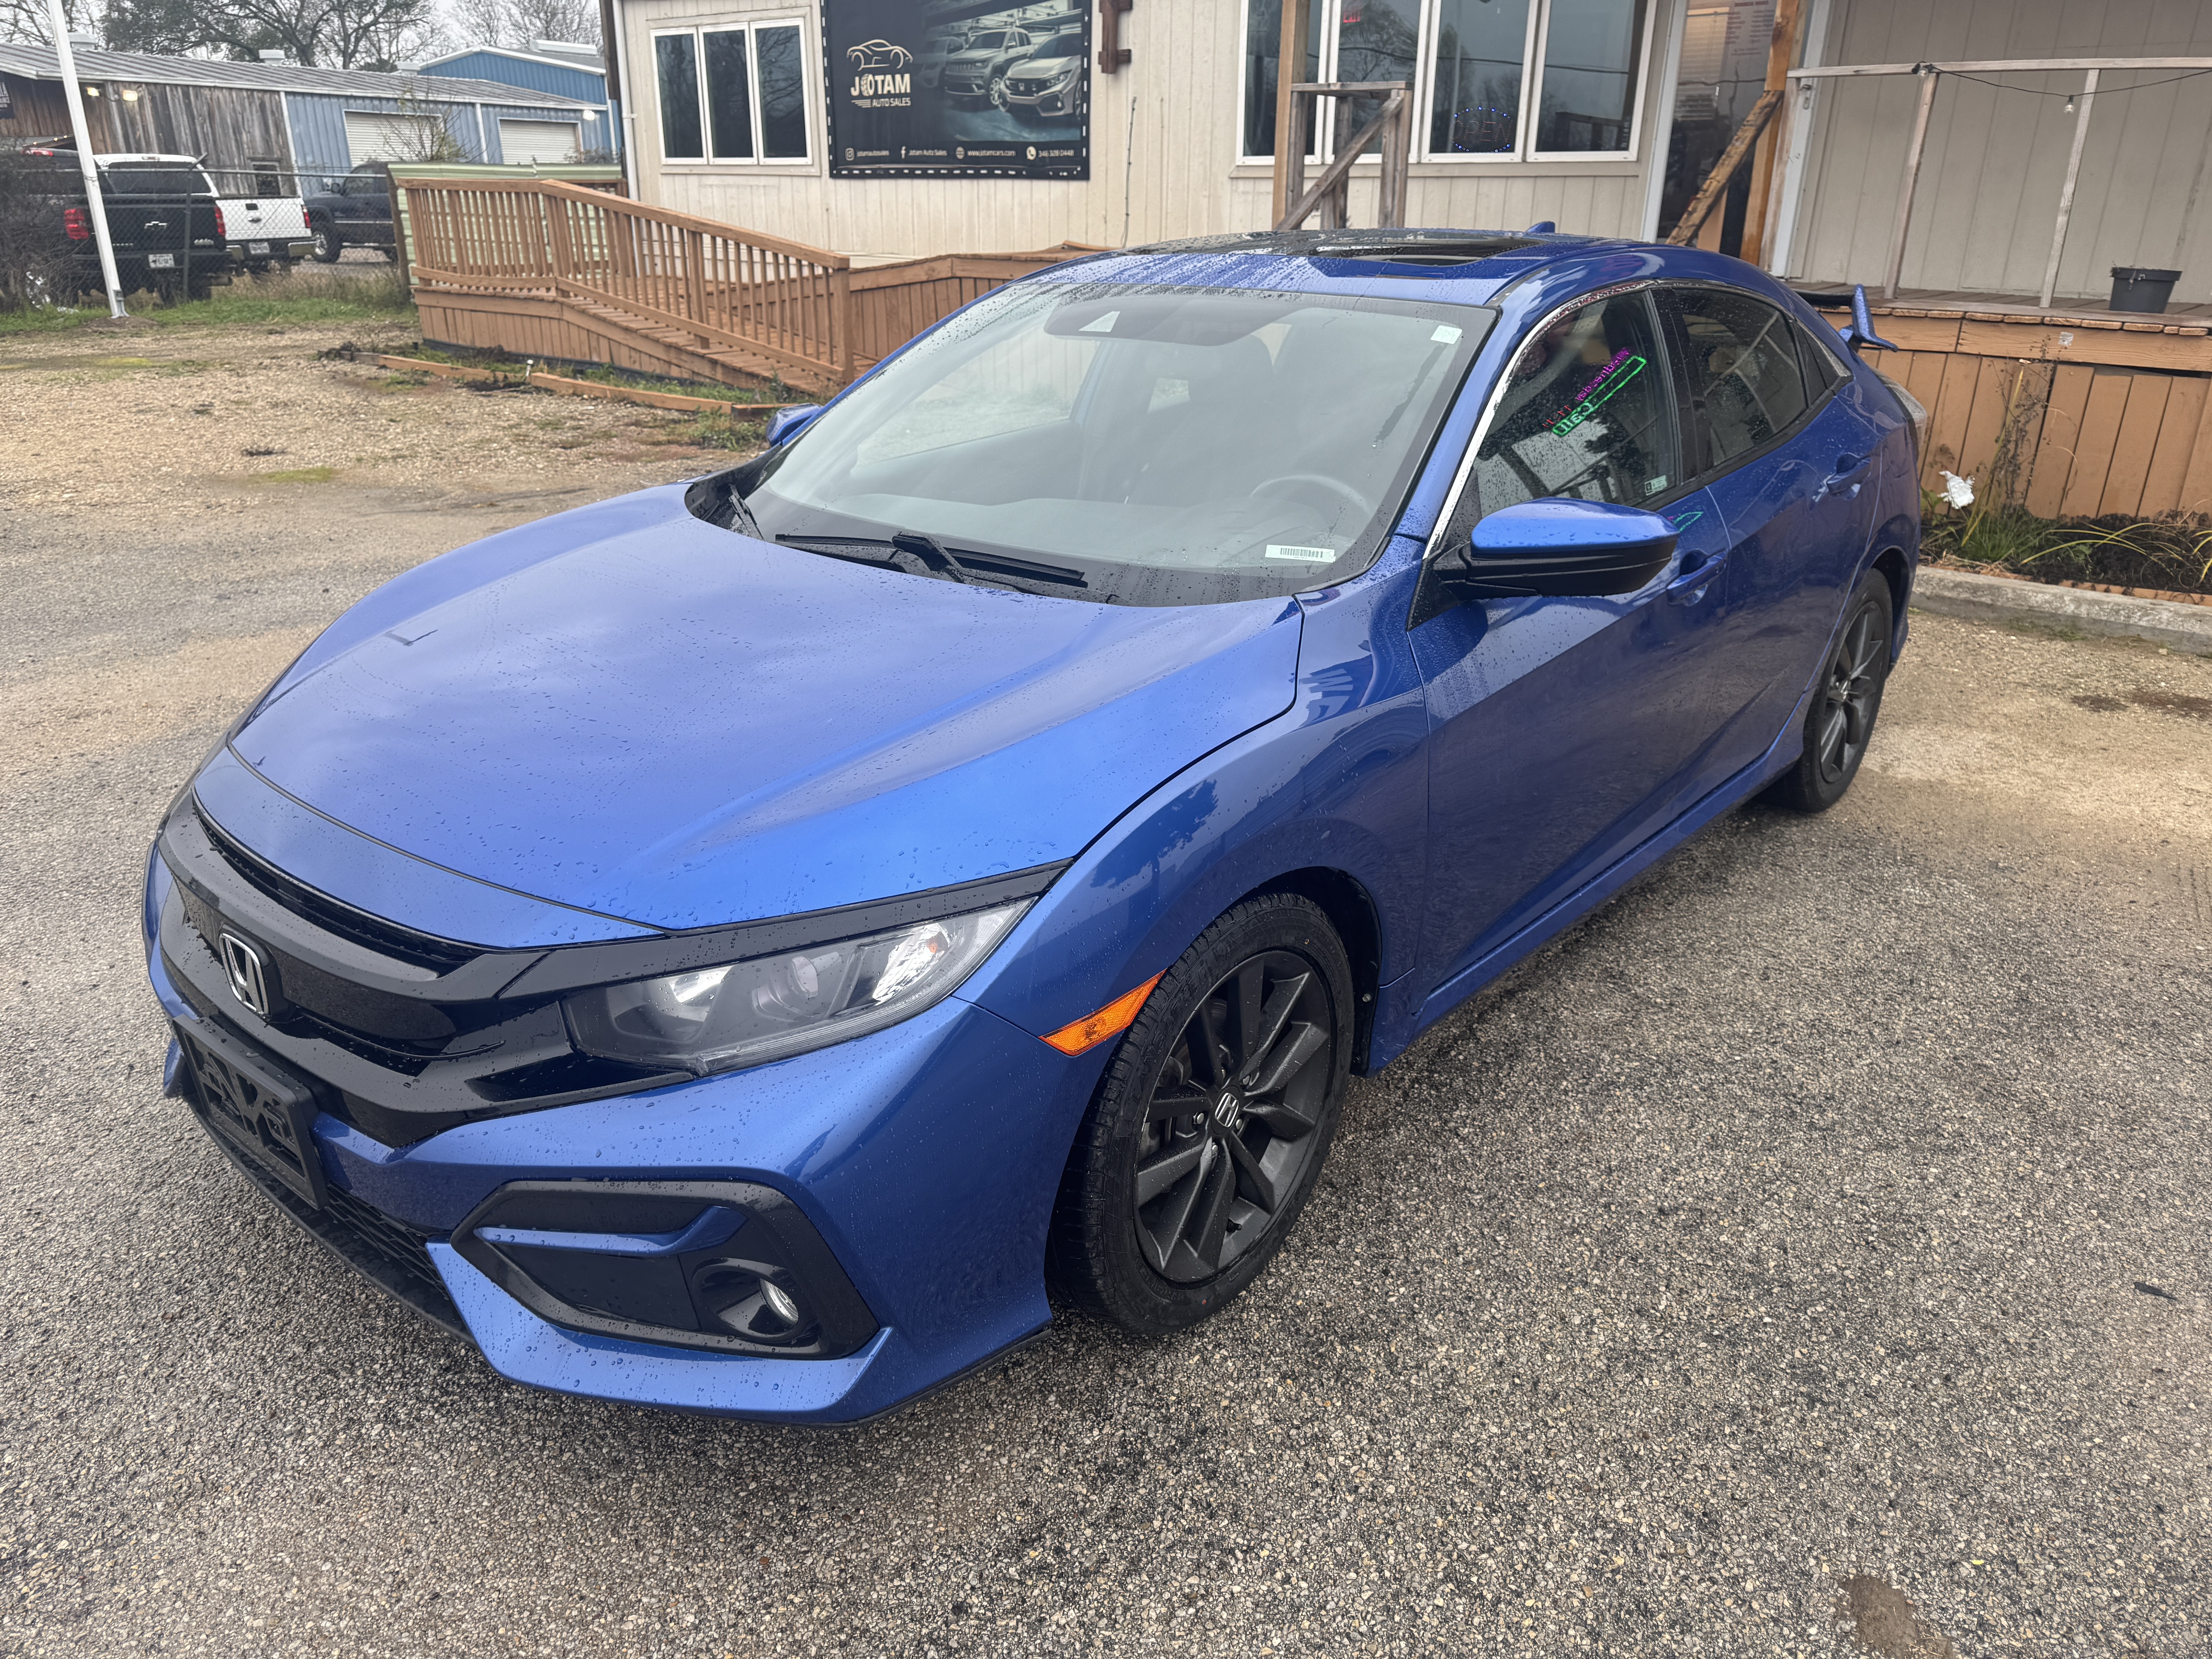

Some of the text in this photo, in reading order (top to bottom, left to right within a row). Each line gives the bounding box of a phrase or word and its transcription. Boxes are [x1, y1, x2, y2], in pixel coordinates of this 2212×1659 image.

[850, 74, 910, 96] JOTAM
[872, 98, 911, 107] AUTO SALES
